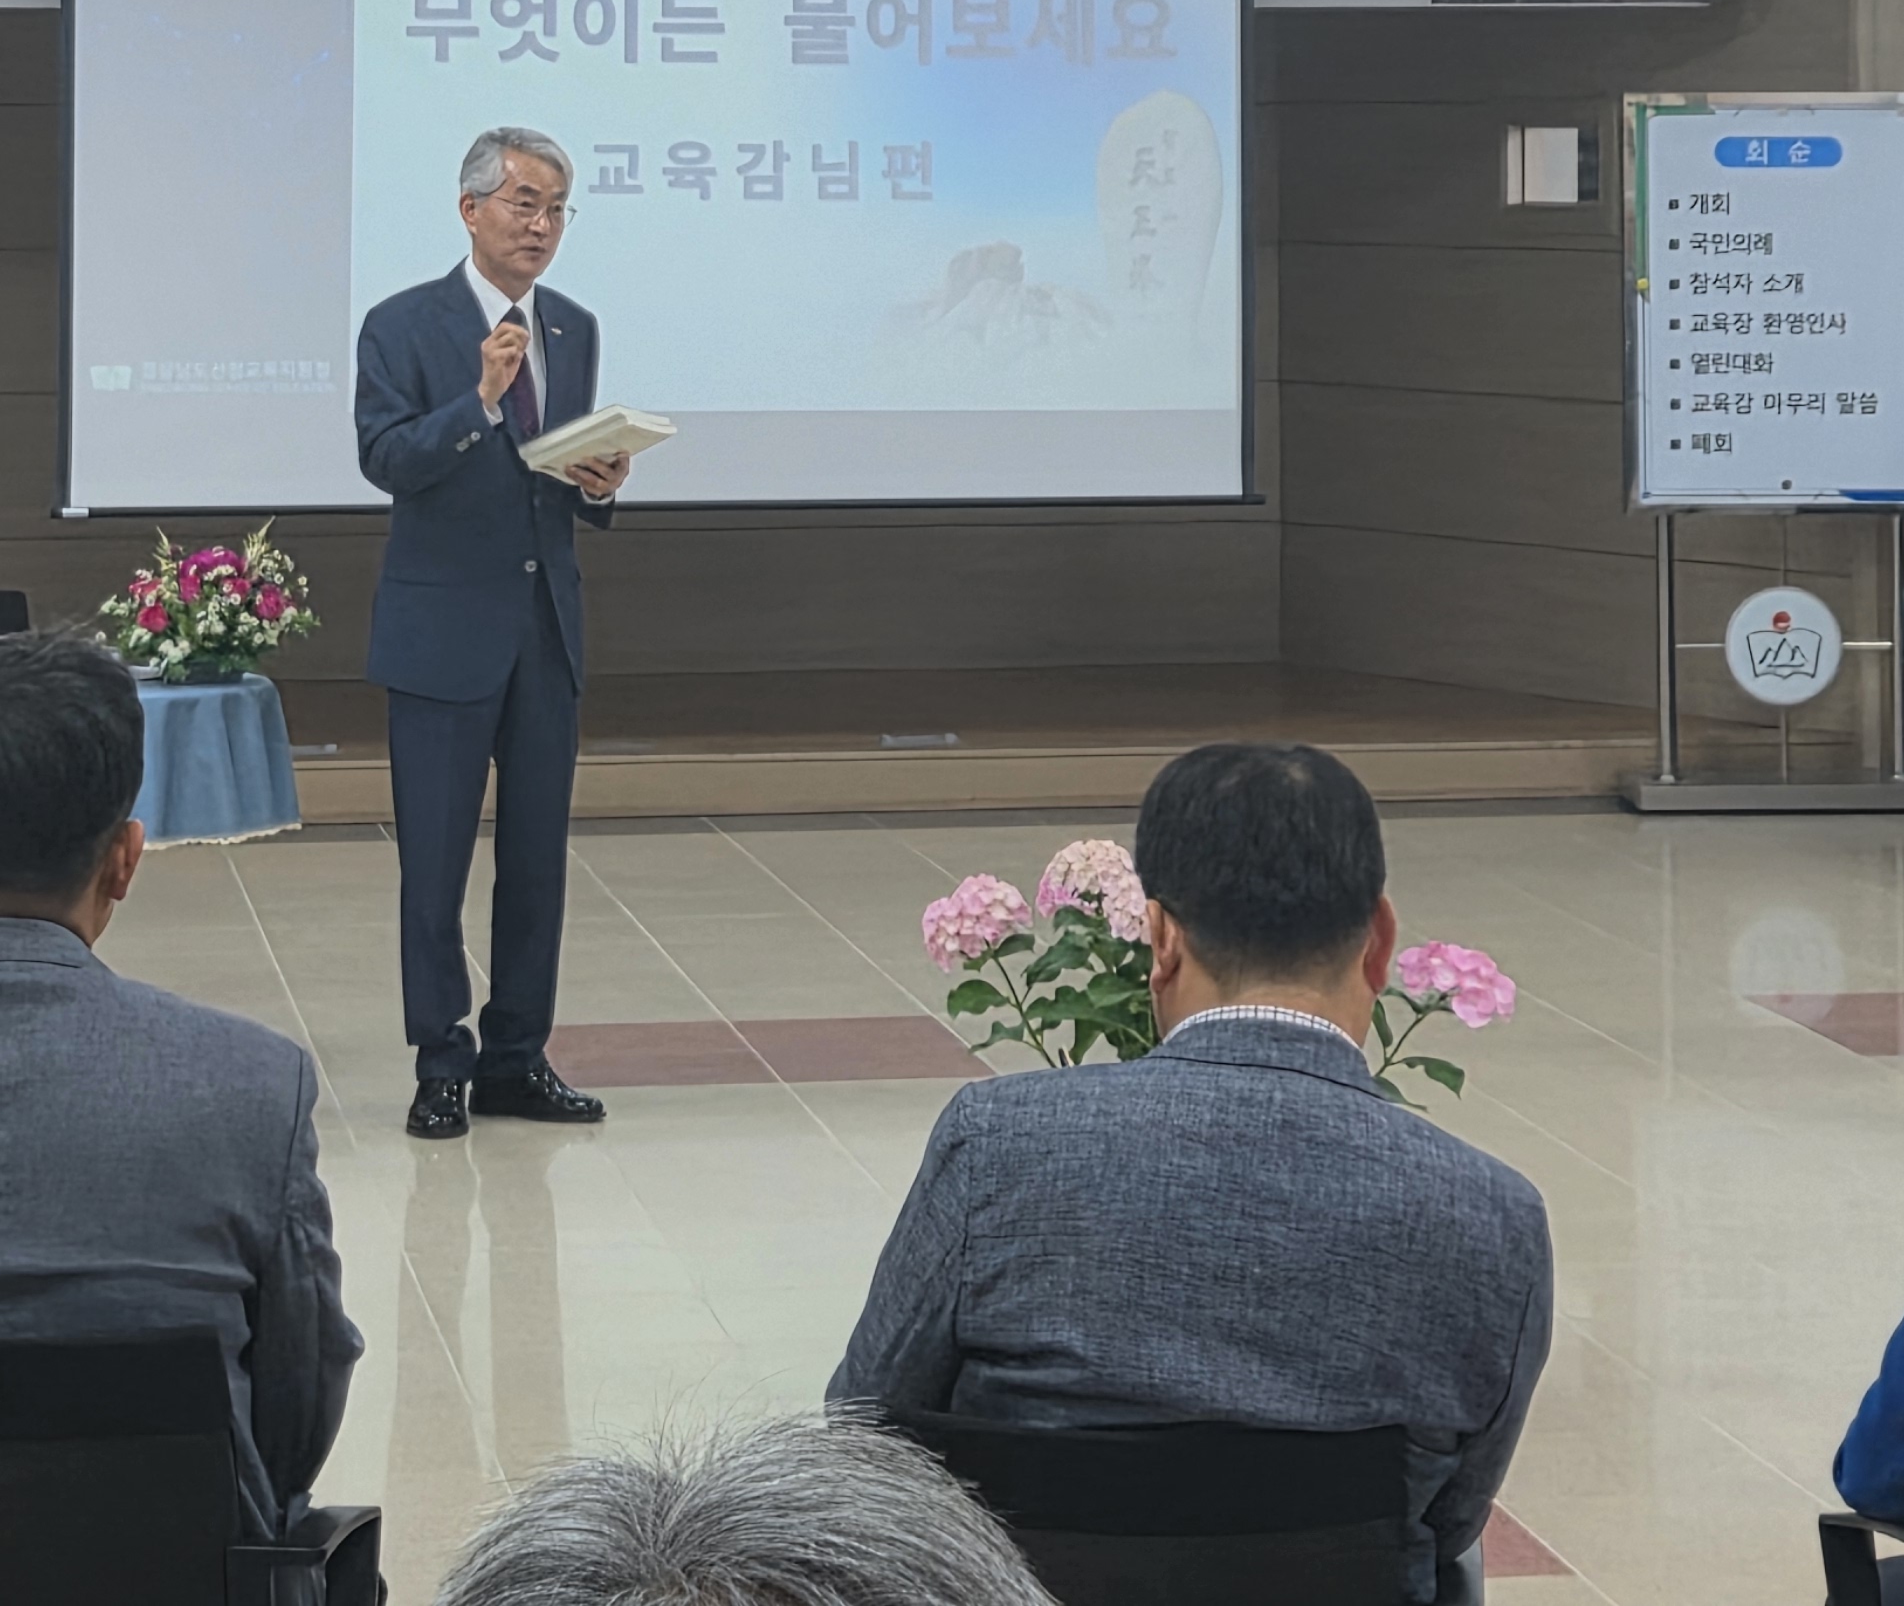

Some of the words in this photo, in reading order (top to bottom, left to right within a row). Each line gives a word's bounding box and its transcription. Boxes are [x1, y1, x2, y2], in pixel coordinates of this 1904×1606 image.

[588, 139, 934, 201] 교육감님편
[1689, 192, 1730, 215] 개회
[1689, 232, 1774, 256] 국민의례
[1689, 272, 1753, 295] 참석자
[1763, 273, 1805, 294] 소개
[1690, 312, 1754, 335] 교육장
[1763, 312, 1847, 335] 환영인사
[1691, 352, 1775, 375] 열린대화
[1691, 392, 1754, 415] 교육감
[1836, 392, 1879, 415] 말씀
